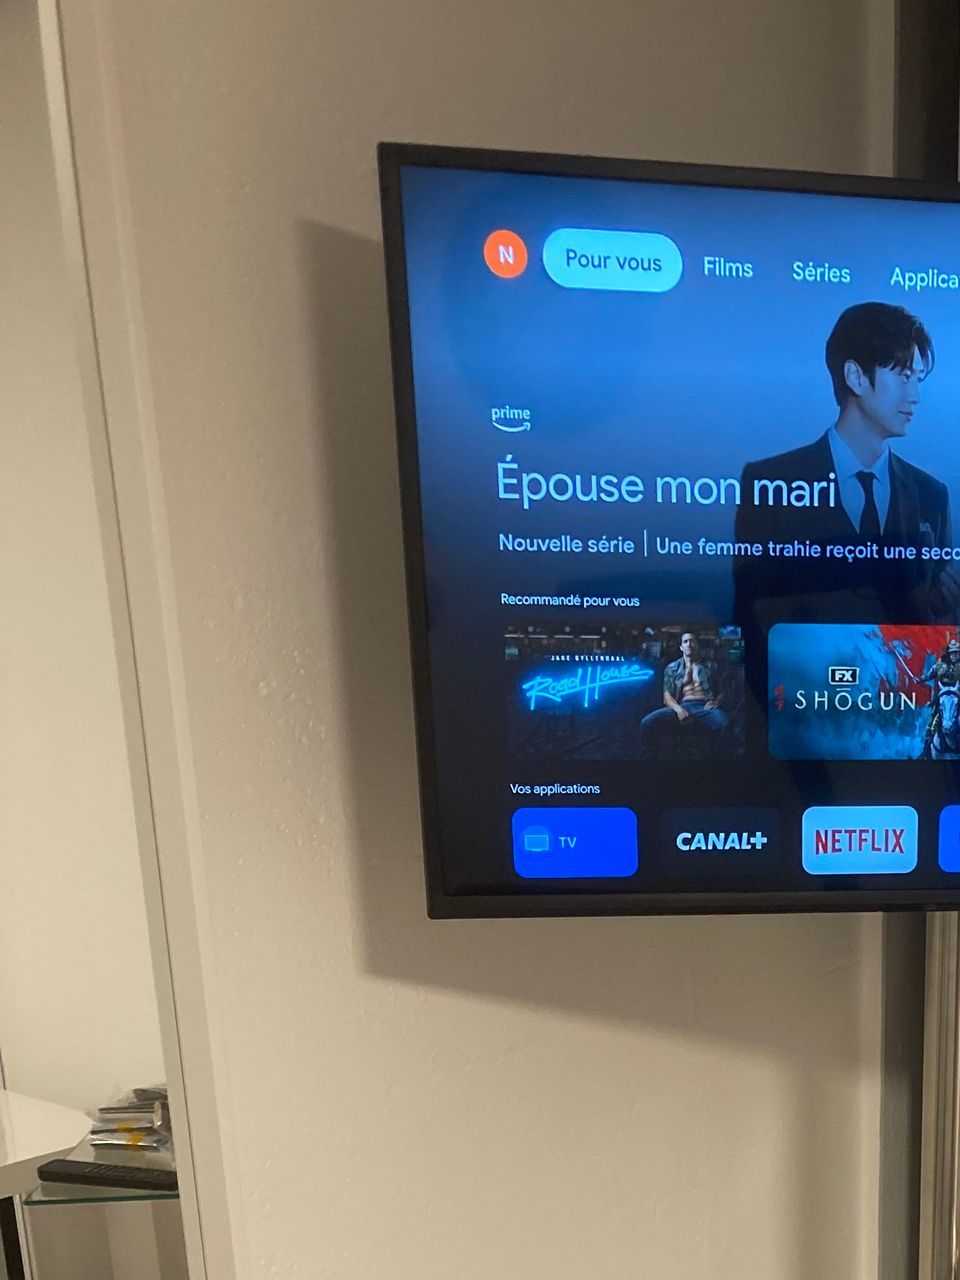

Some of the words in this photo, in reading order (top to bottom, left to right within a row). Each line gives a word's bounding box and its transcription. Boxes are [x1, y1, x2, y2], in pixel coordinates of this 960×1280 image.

[498, 245, 514, 264] N
[566, 248, 611, 270] Pour
[616, 254, 662, 272] vous
[703, 256, 753, 278] Films
[792, 261, 851, 284] Séries
[491, 405, 530, 421] prime
[497, 454, 644, 510] Épouse
[656, 475, 741, 505] mon
[753, 472, 836, 507] mari
[498, 533, 583, 553] Nouvelle
[587, 536, 635, 554] série
[656, 537, 693, 556] Une
[697, 538, 763, 557] femme
[767, 540, 821, 558] trahie
[826, 542, 879, 562] reçoit
[883, 545, 917, 560] une
[501, 592, 581, 607] Recommandé
[583, 596, 610, 608] pour
[612, 597, 640, 607] vous
[522, 668, 582, 710] Road
[583, 663, 654, 707] House
[834, 670, 854, 682] FX
[510, 784, 531, 795] Vos
[533, 784, 600, 796] applications
[559, 837, 577, 848] TV
[676, 831, 768, 851] CANAL+
[815, 828, 906, 856] NETFLIX
